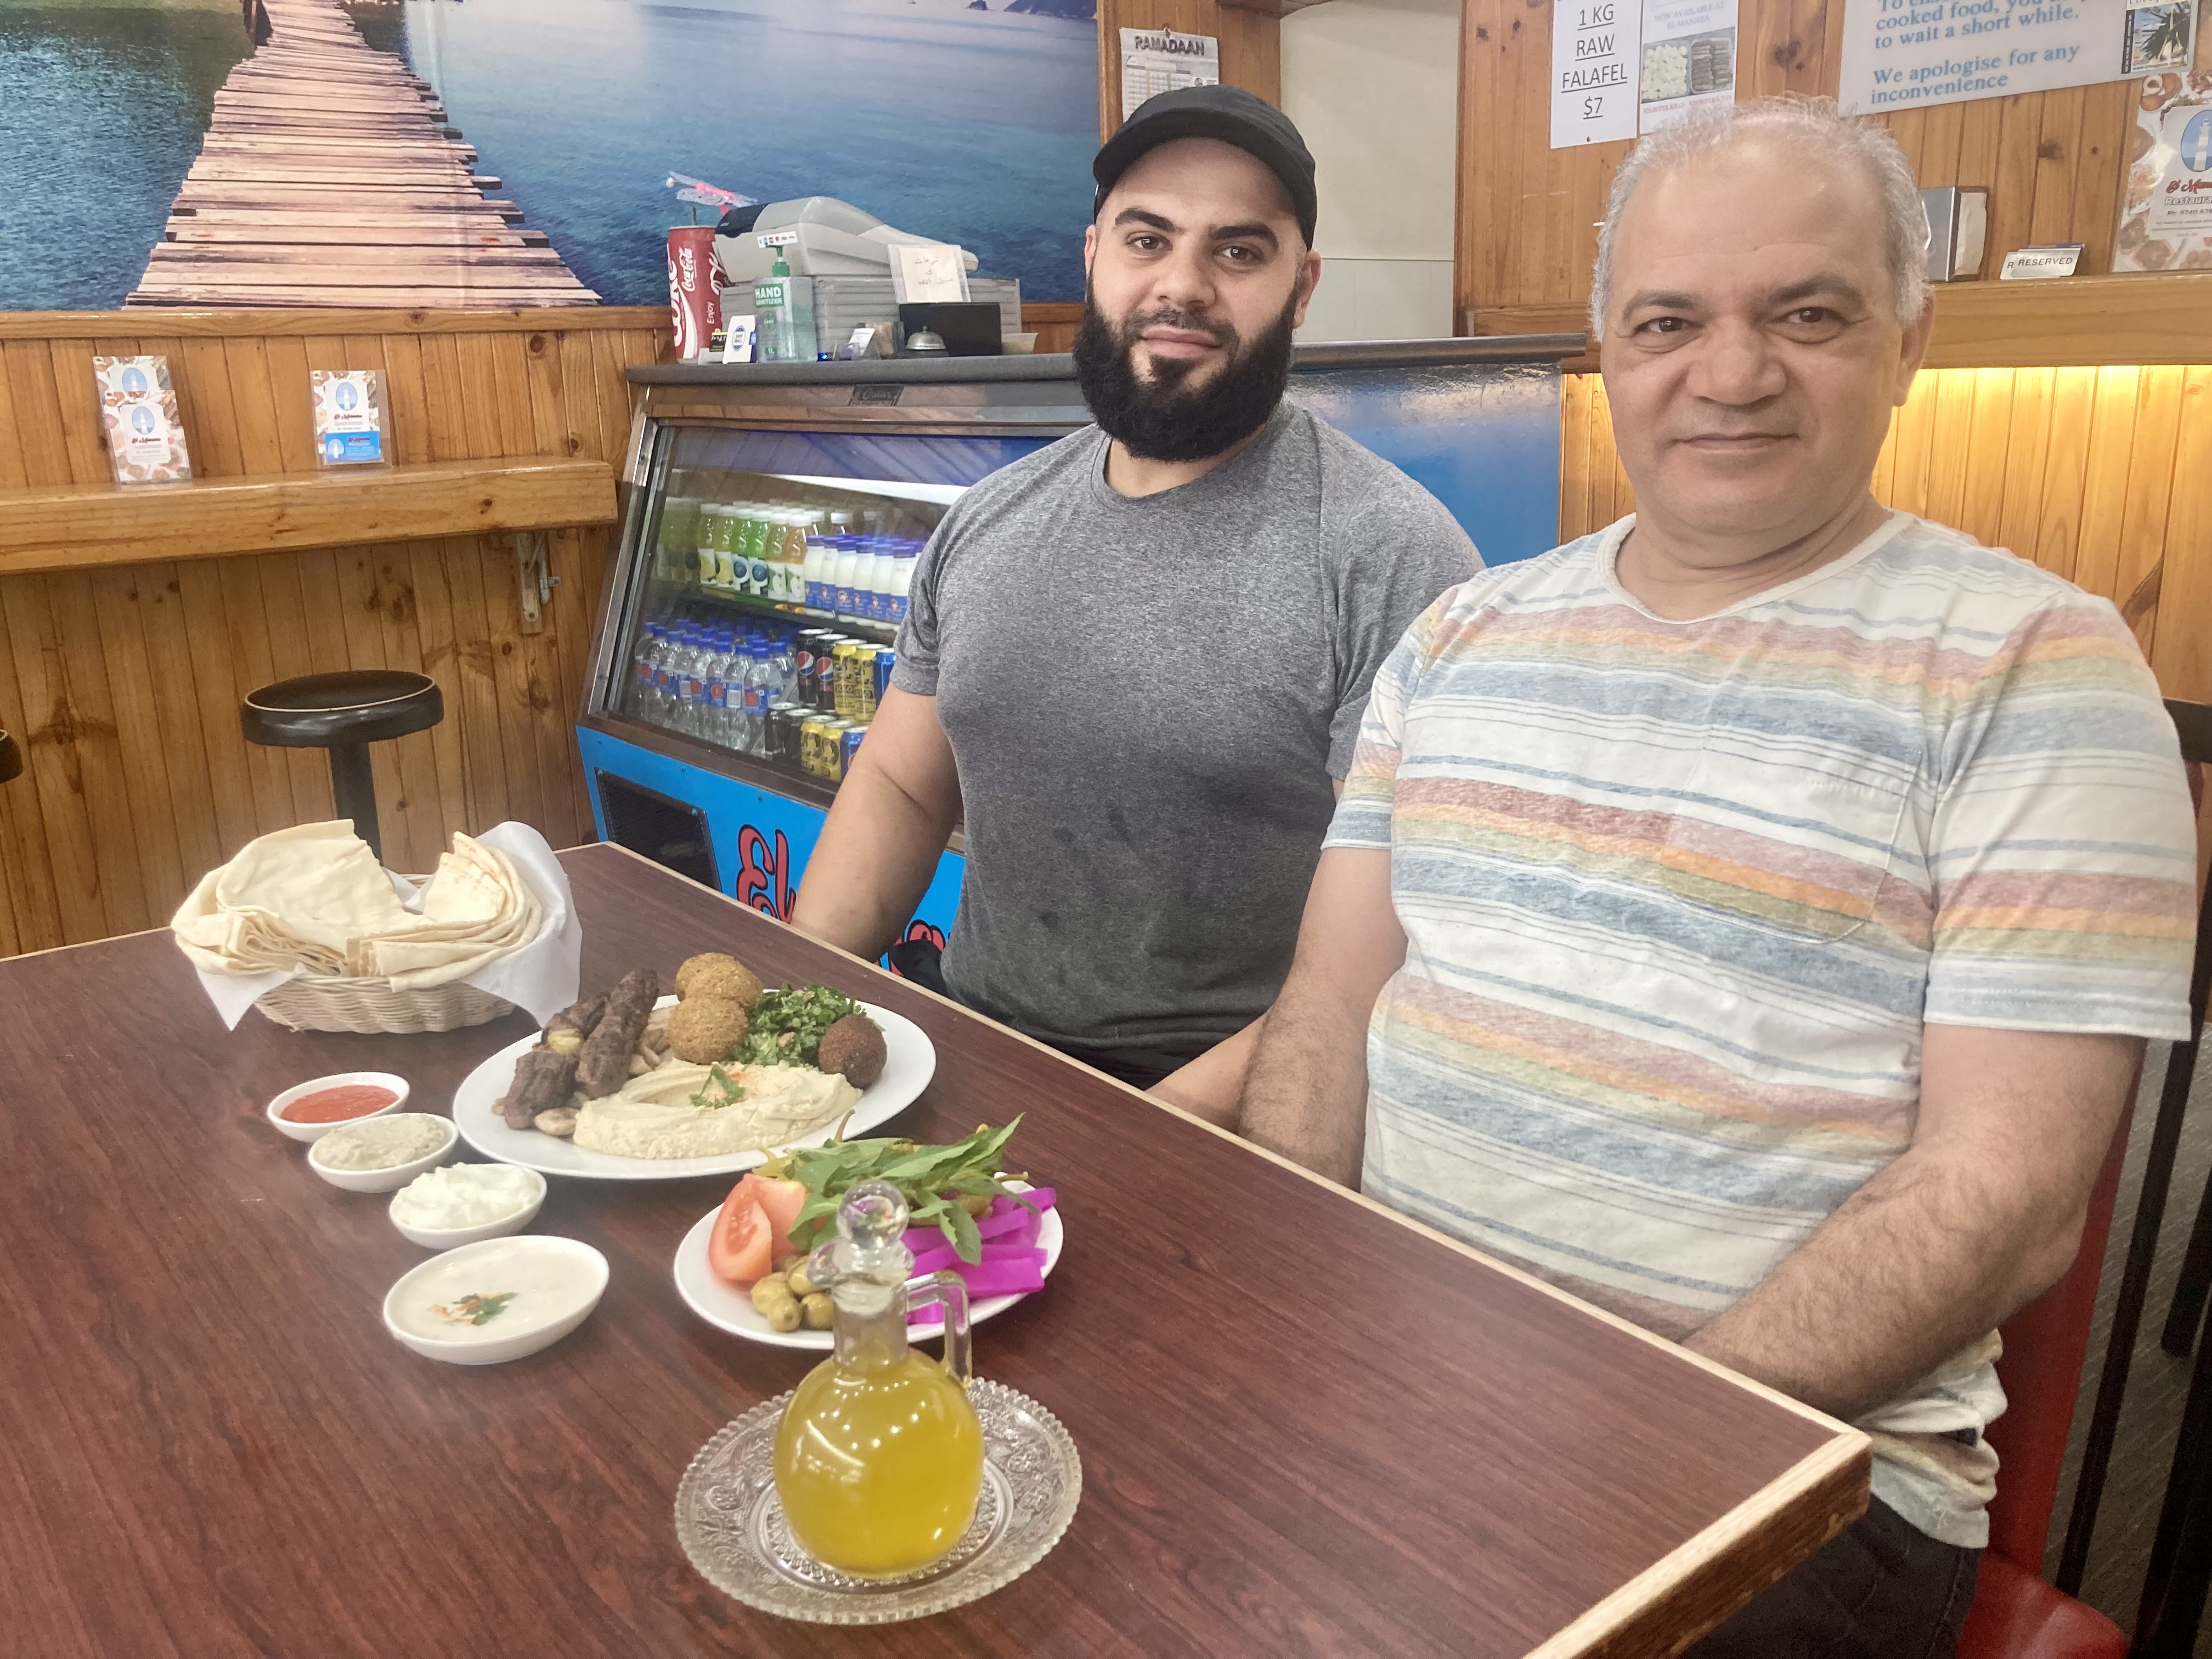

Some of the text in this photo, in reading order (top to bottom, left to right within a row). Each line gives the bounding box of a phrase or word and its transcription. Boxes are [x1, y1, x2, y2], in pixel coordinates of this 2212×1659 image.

[1578, 4, 1614, 26] 1 KG
[1674, 3, 1714, 18] AVAILABLE
[1714, 2, 1725, 10] AT
[1876, 5, 1943, 30] cooked
[1950, 0, 1999, 19] food,
[1875, 4, 2079, 49] to wait a short while.
[1577, 34, 1615, 57] RAW
[1562, 63, 1628, 89] FALAFEL
[1874, 46, 2080, 84] We apologise for any
[1871, 75, 2008, 104] inconvenience
[1584, 96, 1602, 117] $7
[2018, 257, 2073, 267] RESERVED
[755, 286, 782, 299] HAND
[707, 302, 715, 324] Enjoy
[736, 824, 797, 924] El
